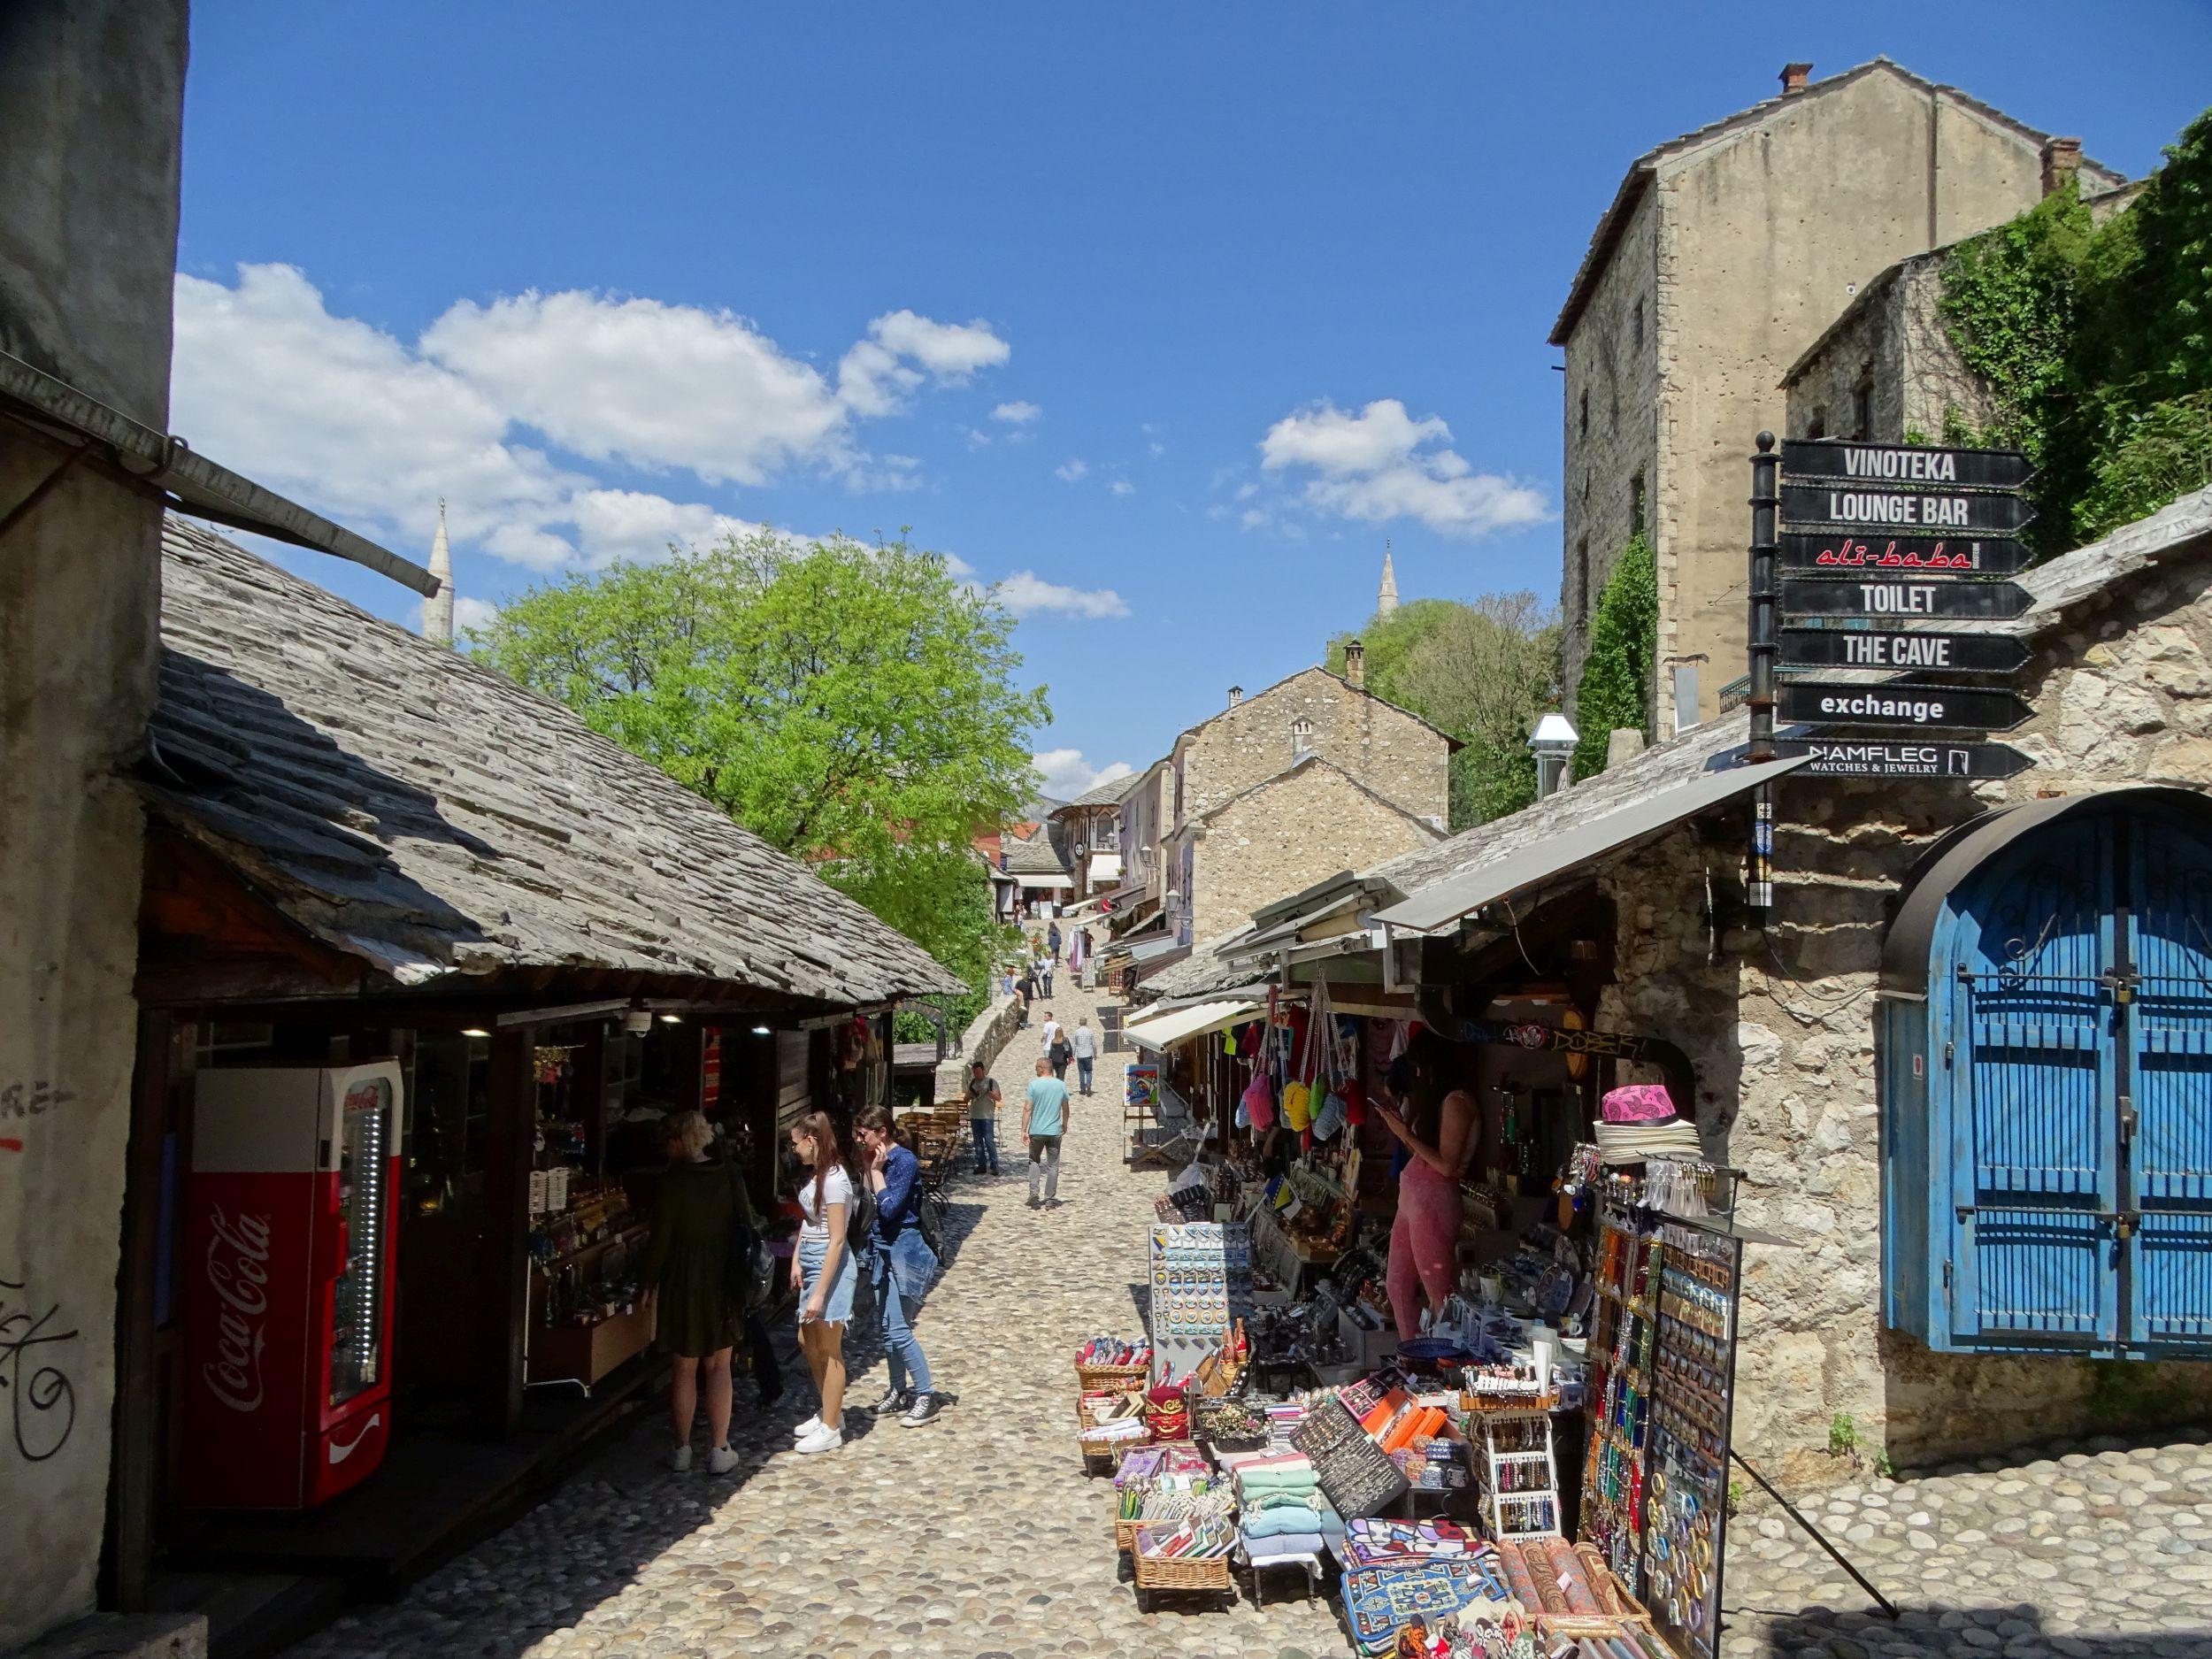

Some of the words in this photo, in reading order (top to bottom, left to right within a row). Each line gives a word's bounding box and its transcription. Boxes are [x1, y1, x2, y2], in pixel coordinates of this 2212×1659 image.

[1844, 449, 1956, 480] VINOTEKA
[1830, 493, 1916, 523] LOUNGE
[1923, 496, 1968, 526] BAR
[1816, 539, 1972, 569] ali-baba
[1860, 585, 1936, 613] TOILET
[1843, 635, 1886, 664] THE
[1892, 637, 1950, 666] CAVE
[1820, 695, 1944, 722] exchange
[1810, 763, 1869, 772] WATCHES
[1871, 764, 1880, 772] &
[1885, 764, 1939, 773] JEWELRY
[203, 1202, 270, 1412] Coca-Cola
